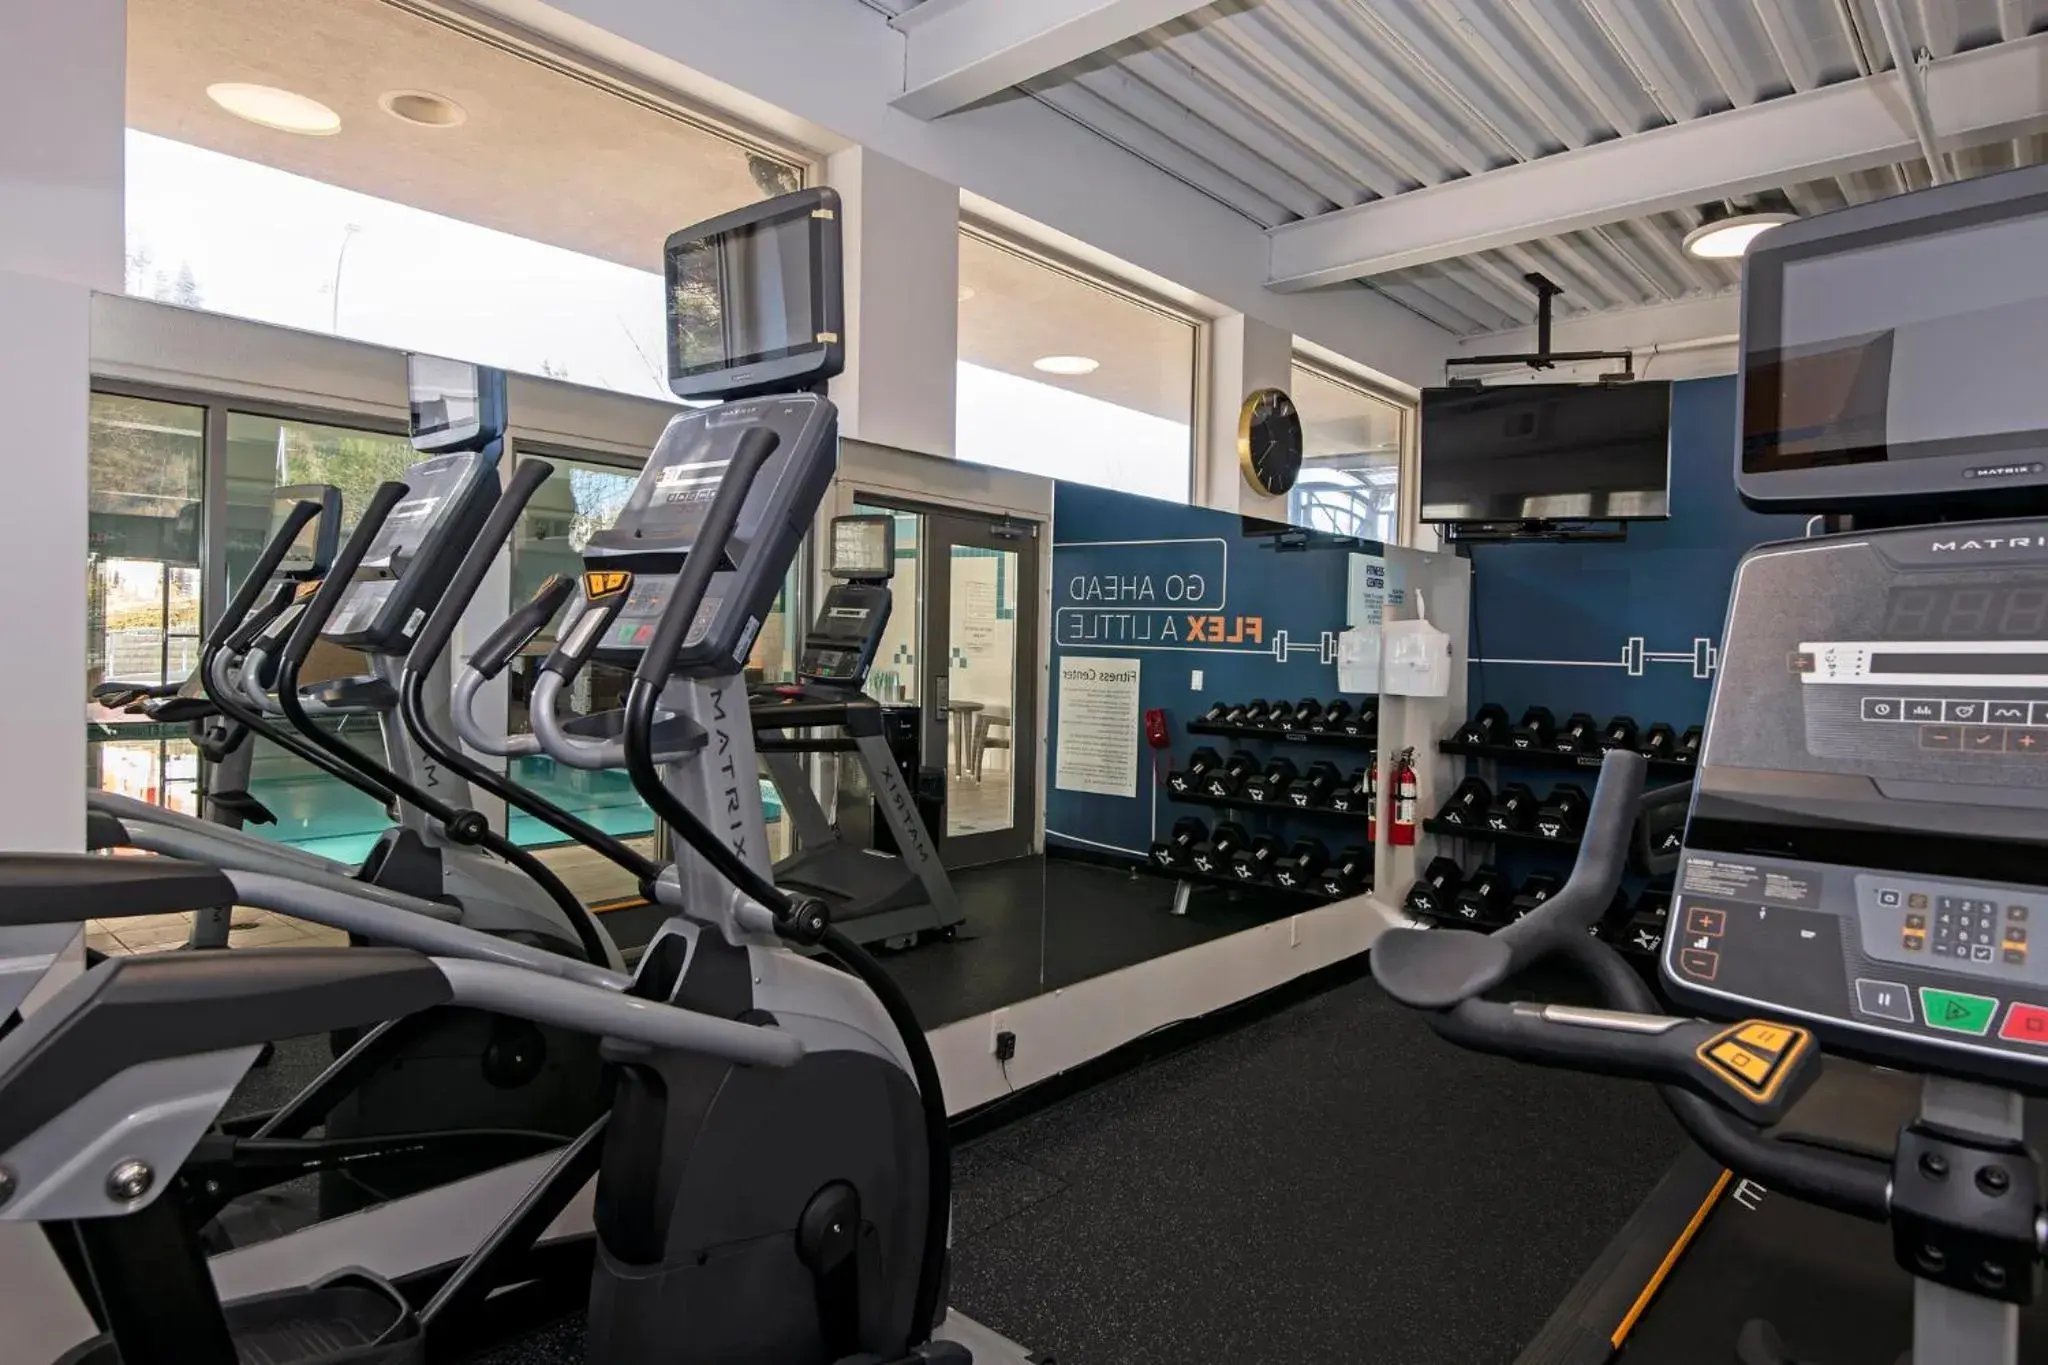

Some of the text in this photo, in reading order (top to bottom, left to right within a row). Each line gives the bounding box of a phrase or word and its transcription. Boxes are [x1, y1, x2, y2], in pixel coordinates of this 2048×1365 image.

[1977, 466, 2028, 476] MATRIX
[1932, 536, 2048, 551] MATRI
[710, 689, 747, 860] MATRIX
[1961, 902, 1971, 911] 2
[1982, 904, 1991, 913] 3
[1940, 914, 1949, 923] 4
